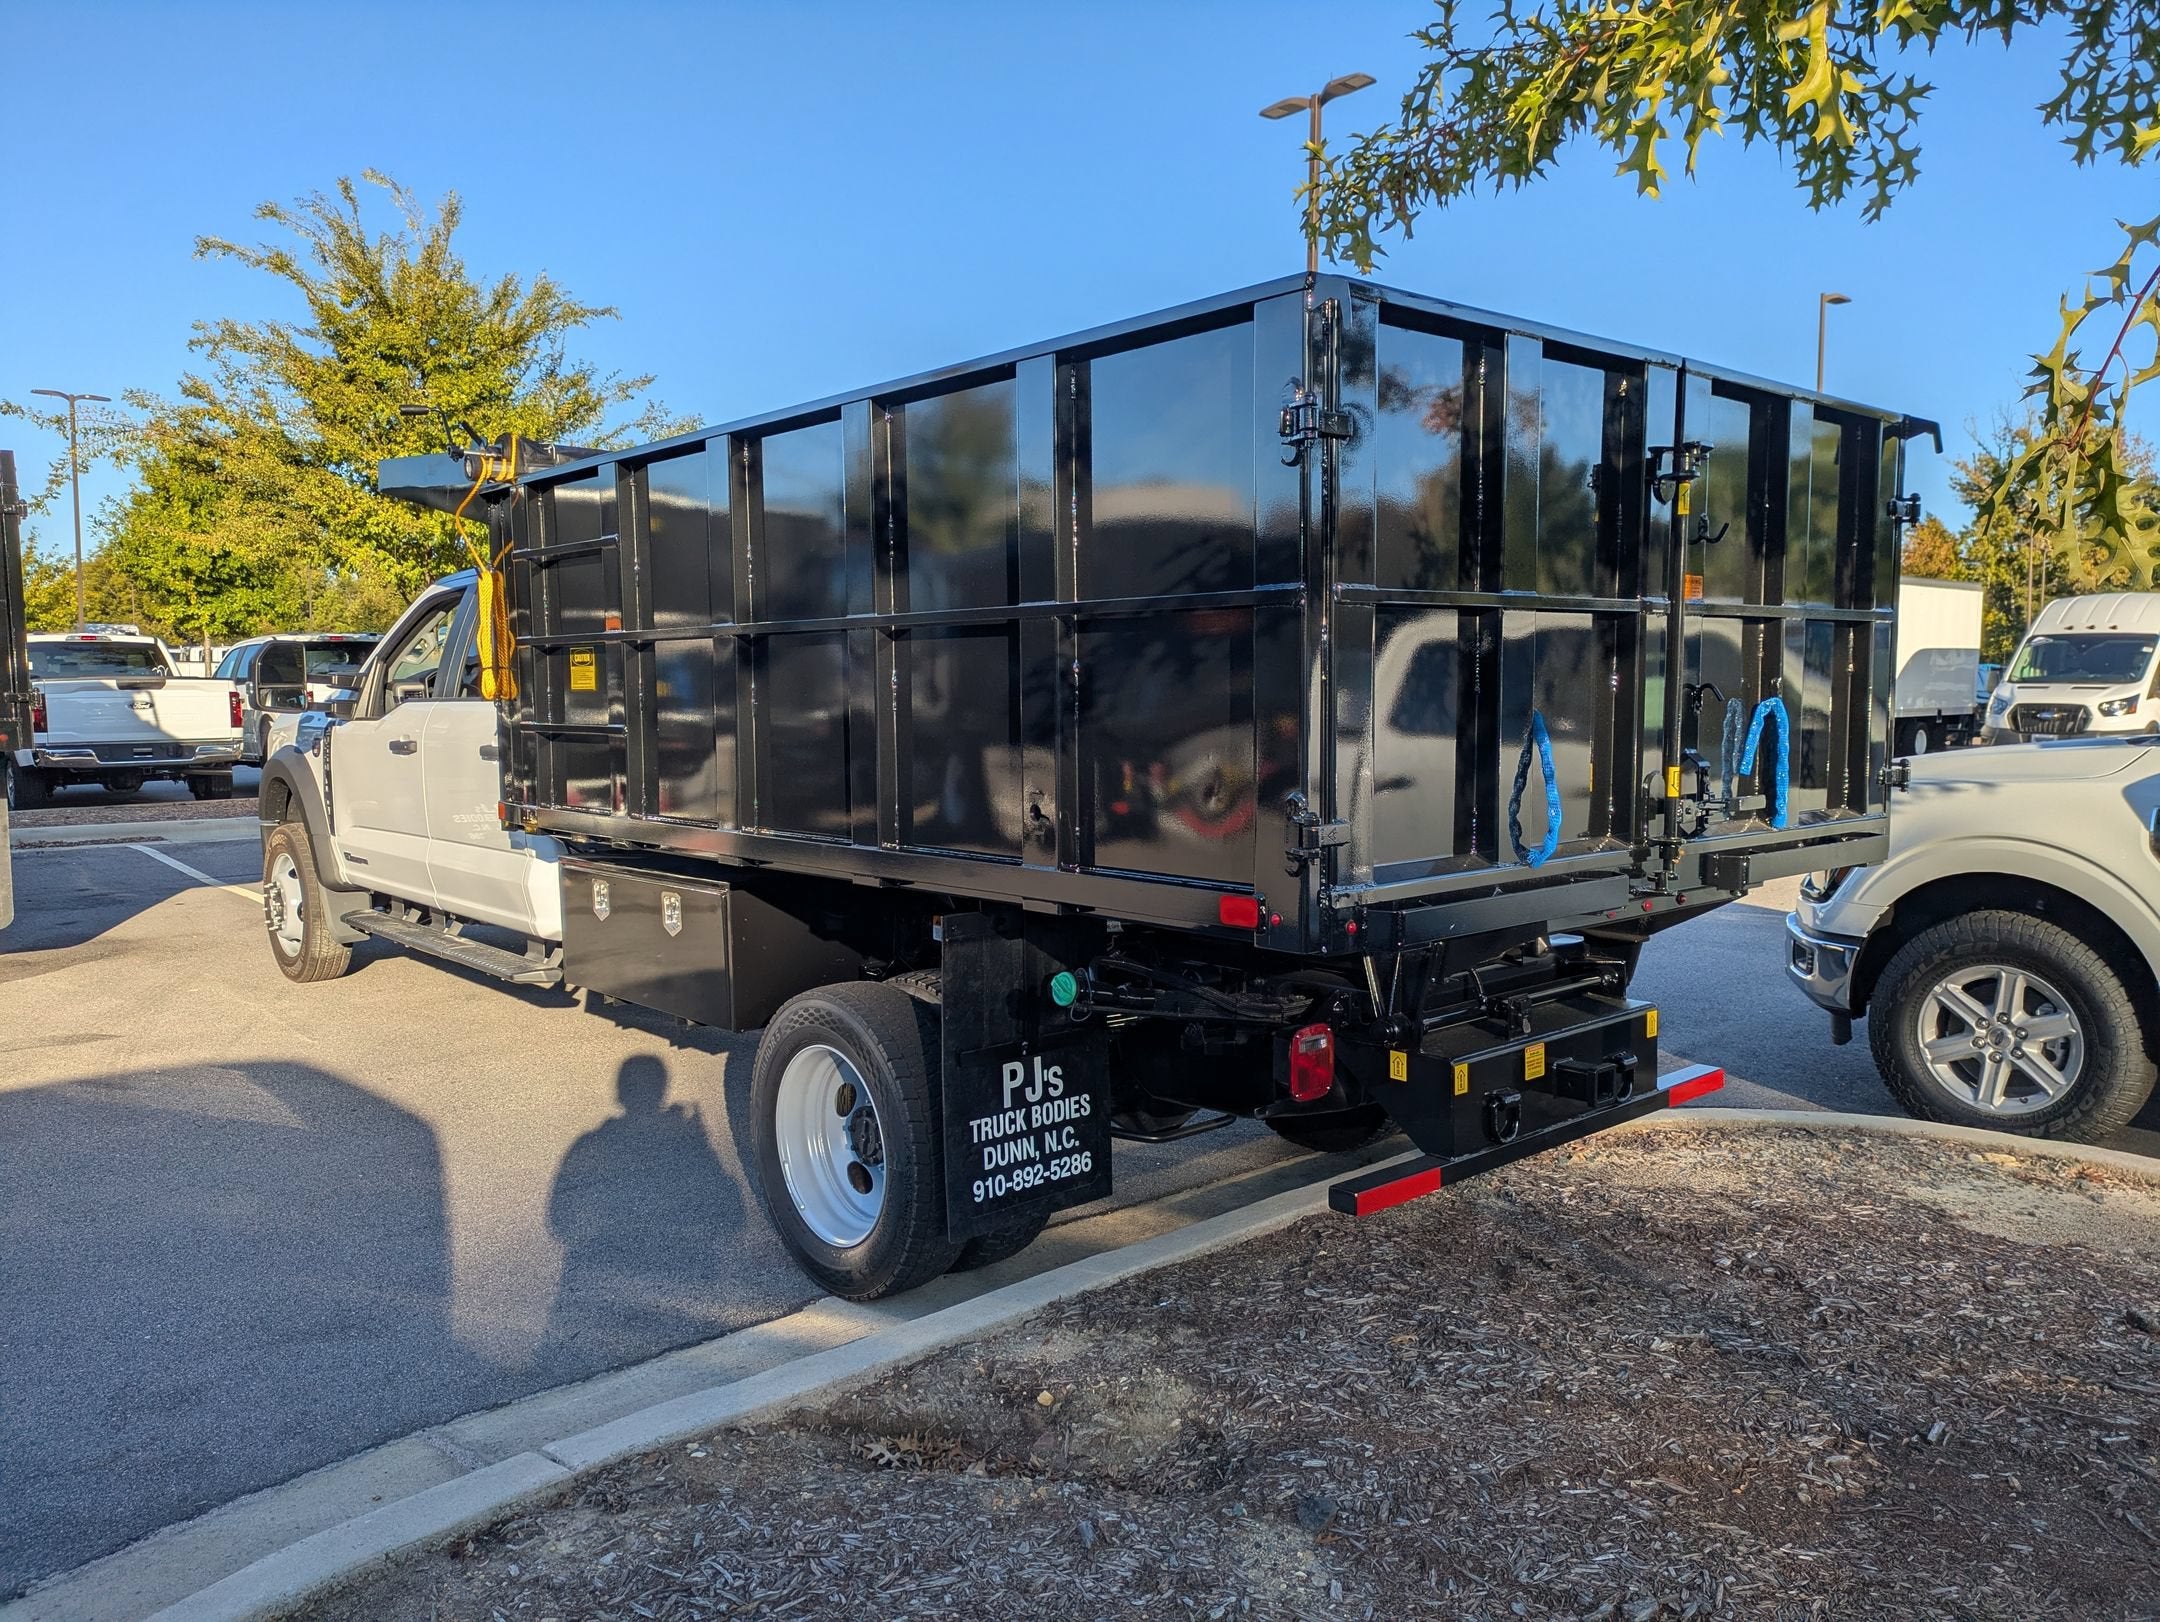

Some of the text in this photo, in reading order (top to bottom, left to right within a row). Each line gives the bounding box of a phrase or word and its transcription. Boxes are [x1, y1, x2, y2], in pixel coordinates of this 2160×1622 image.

[969, 1093, 1091, 1143] TRUCK BODIES
[983, 1126, 1080, 1170] DUNN, N.C.
[972, 1151, 1092, 1203] 910-892-5286
